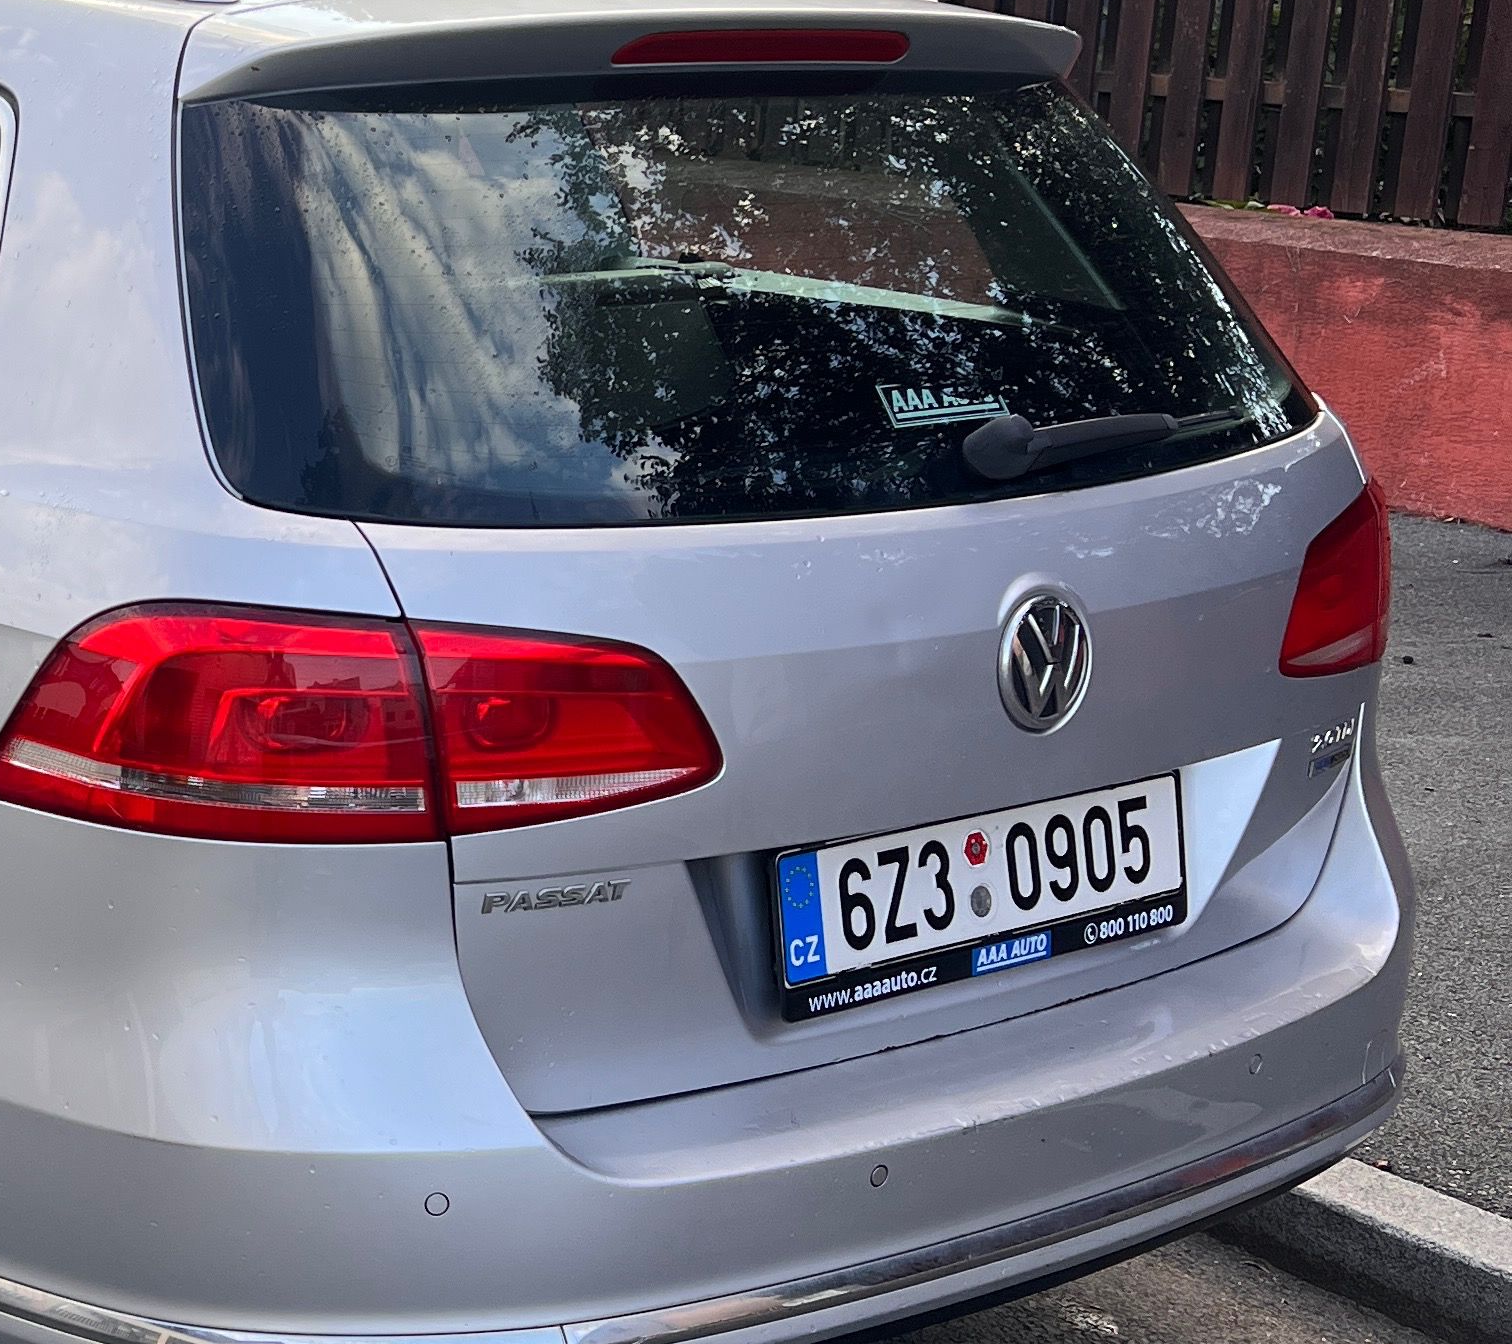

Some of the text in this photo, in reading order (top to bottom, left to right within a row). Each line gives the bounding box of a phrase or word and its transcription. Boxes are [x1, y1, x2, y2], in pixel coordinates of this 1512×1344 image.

[891, 388, 939, 412] AAA
[838, 795, 1150, 951] 6Z3 0905
[481, 878, 632, 914] PASSAT
[1099, 904, 1174, 940] 800 110 800
[789, 934, 821, 968] CZ
[976, 932, 1048, 968] AAA AUTO
[808, 965, 938, 1012] www.aaaauto.cz
